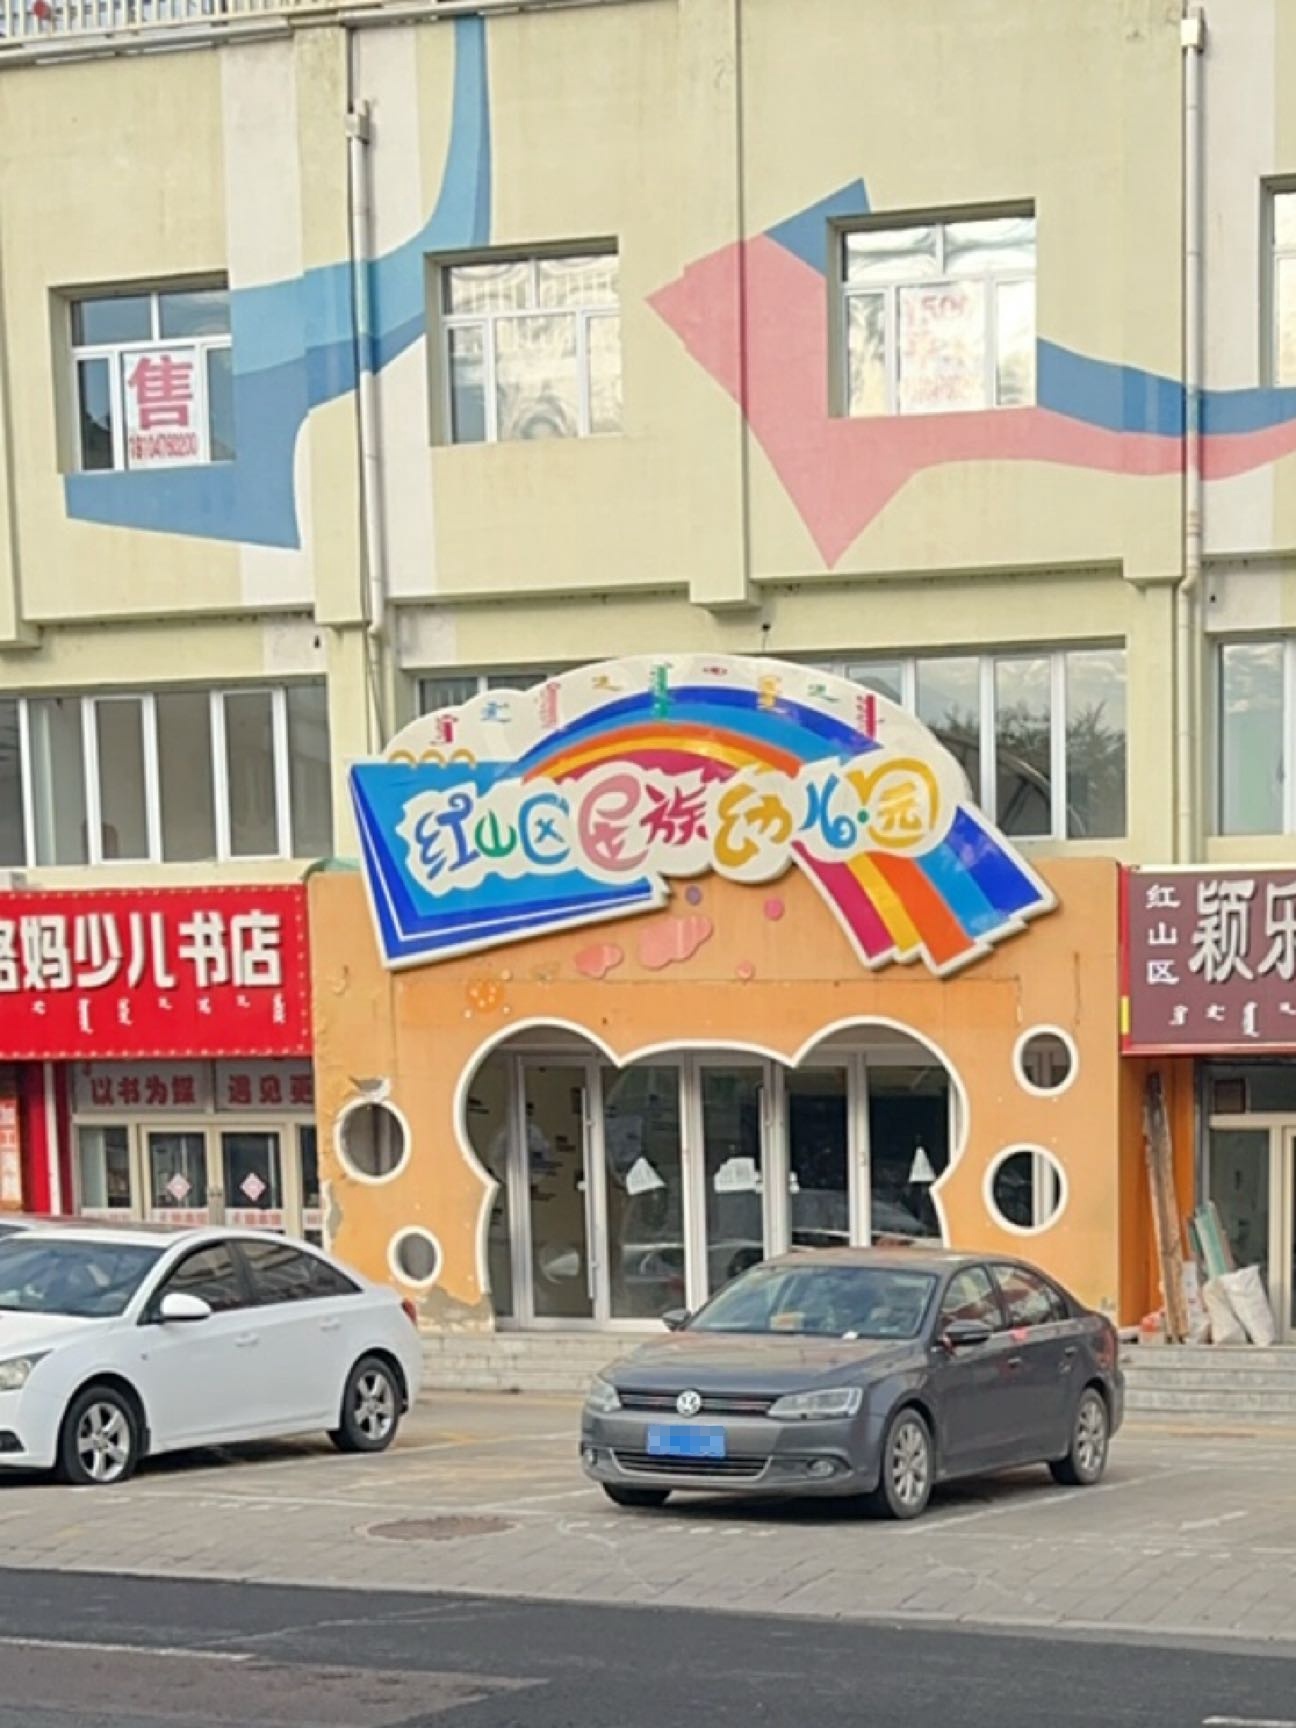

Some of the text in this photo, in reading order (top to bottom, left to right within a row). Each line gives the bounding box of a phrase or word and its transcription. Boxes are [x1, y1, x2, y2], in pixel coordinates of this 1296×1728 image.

[127, 353, 194, 431] 售
[414, 755, 940, 880] 红山区民族幼儿园
[1145, 884, 1181, 986] 红山区
